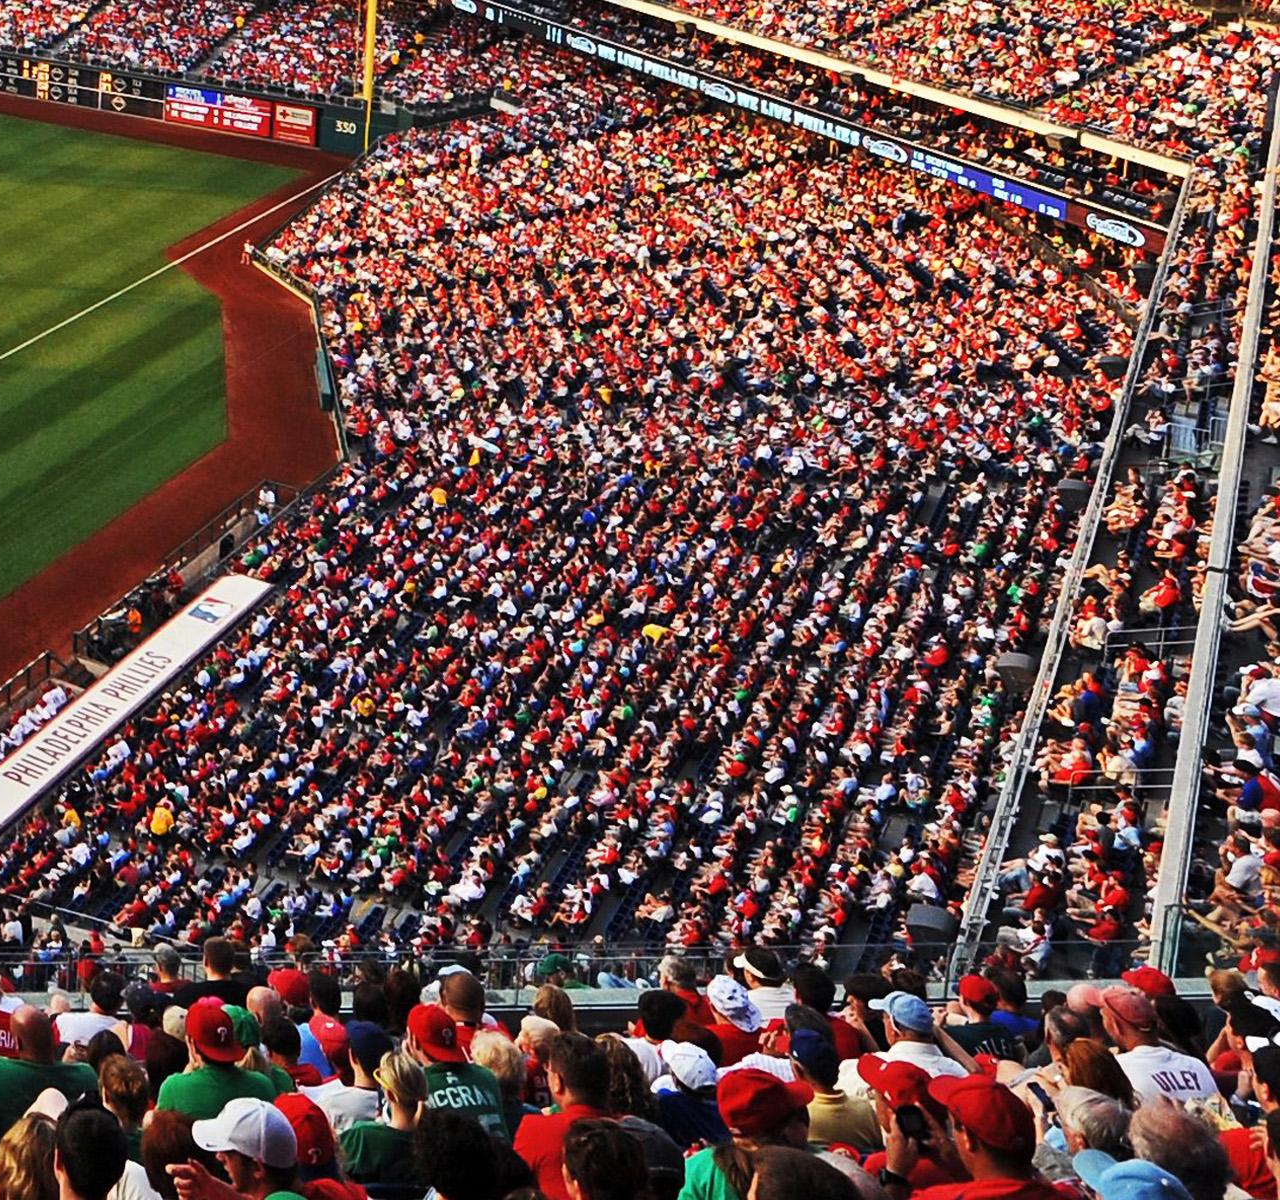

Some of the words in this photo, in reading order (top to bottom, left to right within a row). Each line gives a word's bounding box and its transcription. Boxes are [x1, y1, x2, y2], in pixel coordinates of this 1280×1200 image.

[794, 110, 860, 147] PHILLIES
[3, 702, 114, 787] PHILADELPHIA
[108, 650, 173, 701] PHILLIES
[1151, 1069, 1202, 1092] UTLEY
